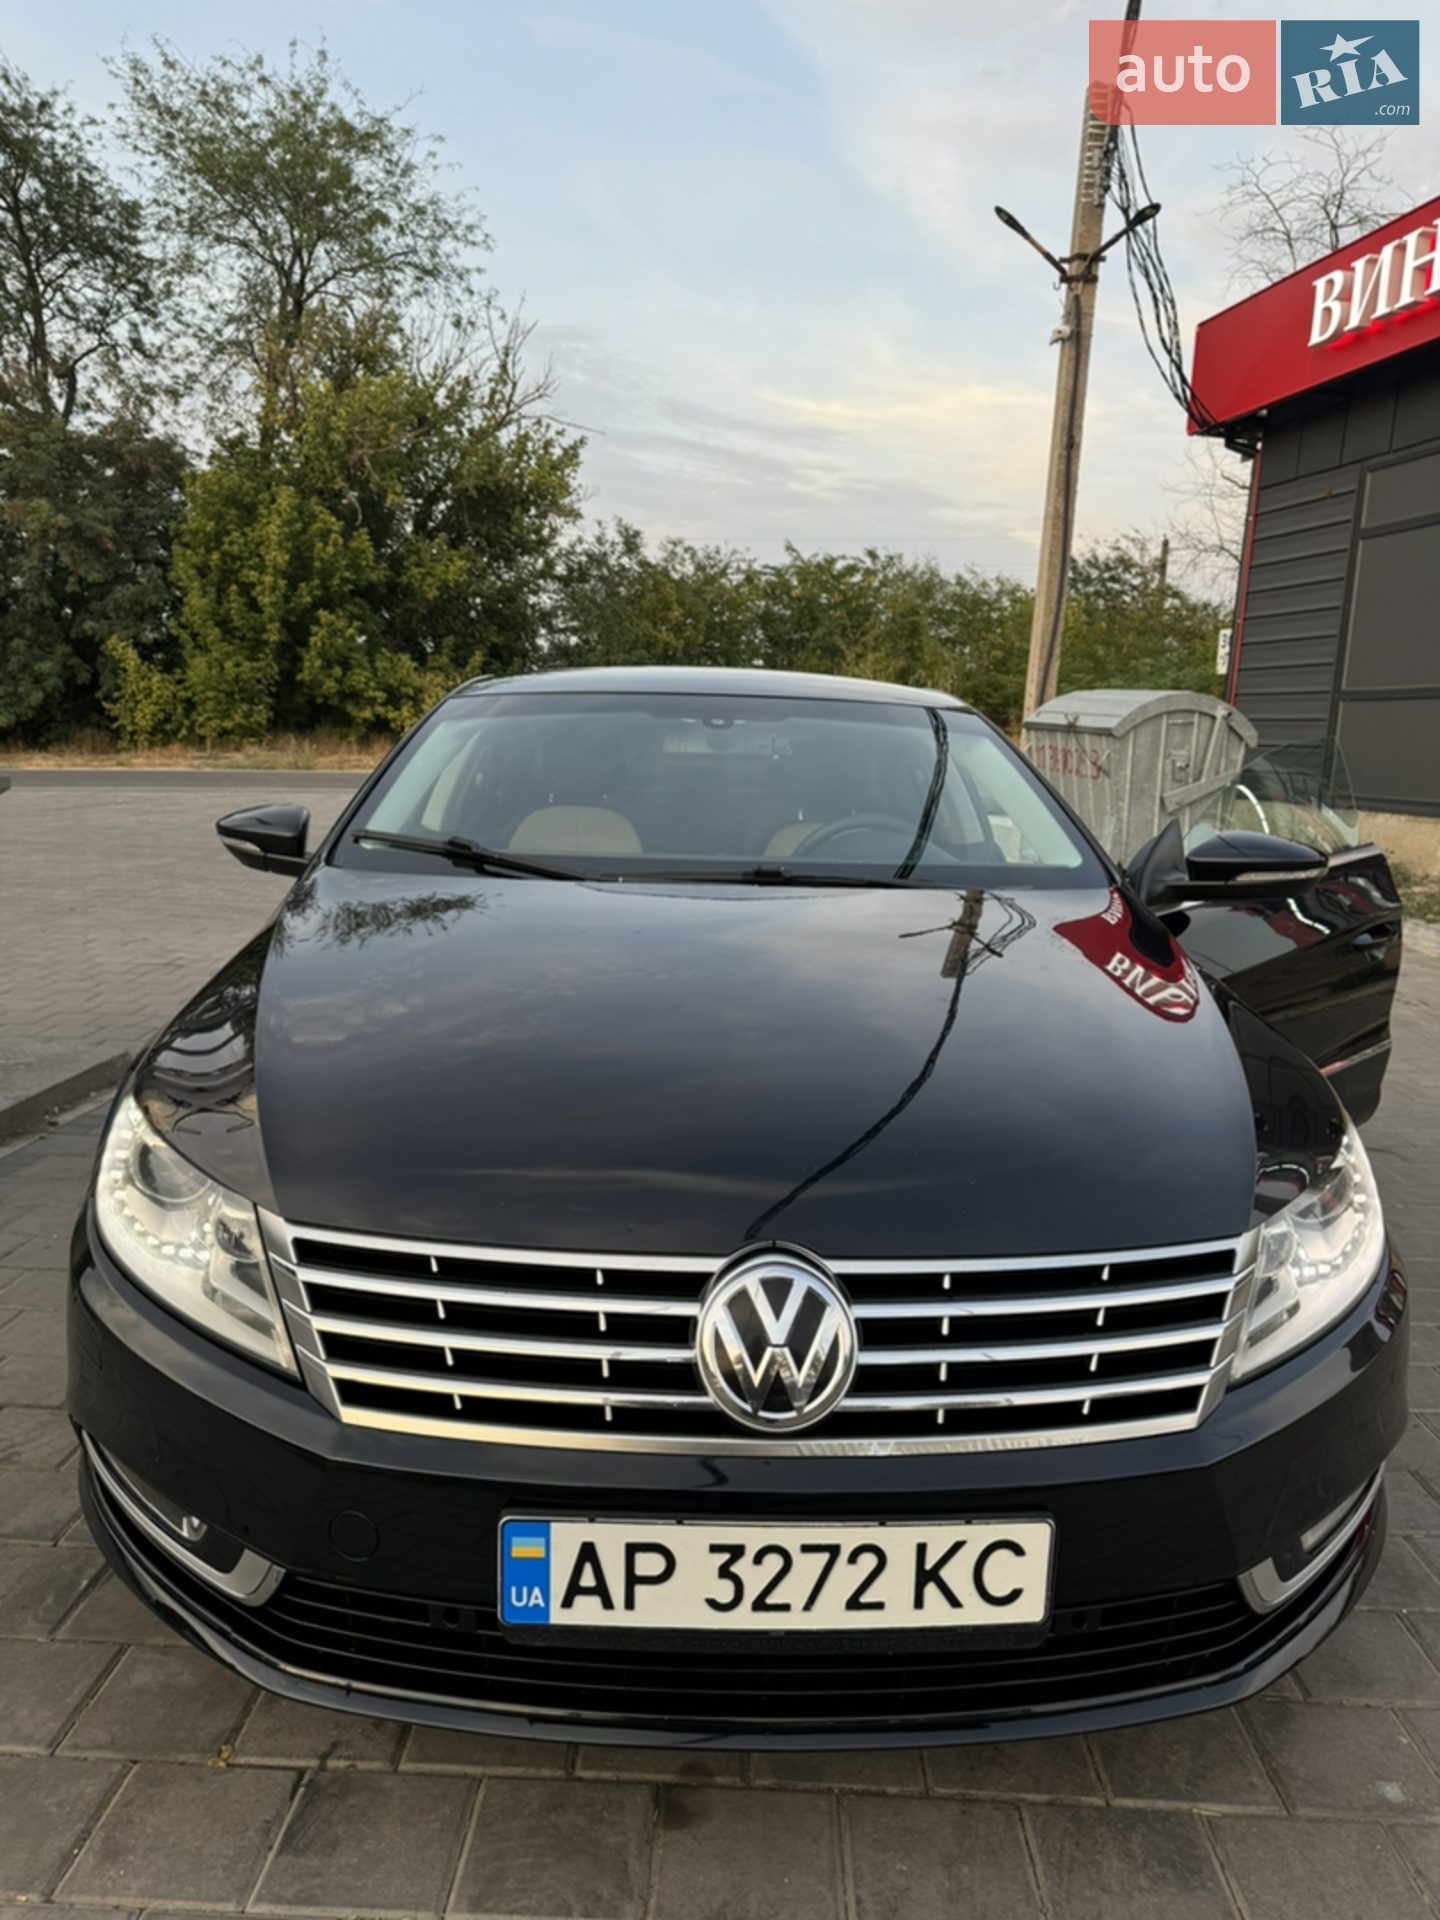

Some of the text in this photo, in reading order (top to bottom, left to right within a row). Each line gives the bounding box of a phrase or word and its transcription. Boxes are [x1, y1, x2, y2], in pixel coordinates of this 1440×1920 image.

[511, 1587, 545, 1607] UA
[560, 1539, 1027, 1613] AP 3272 KC
